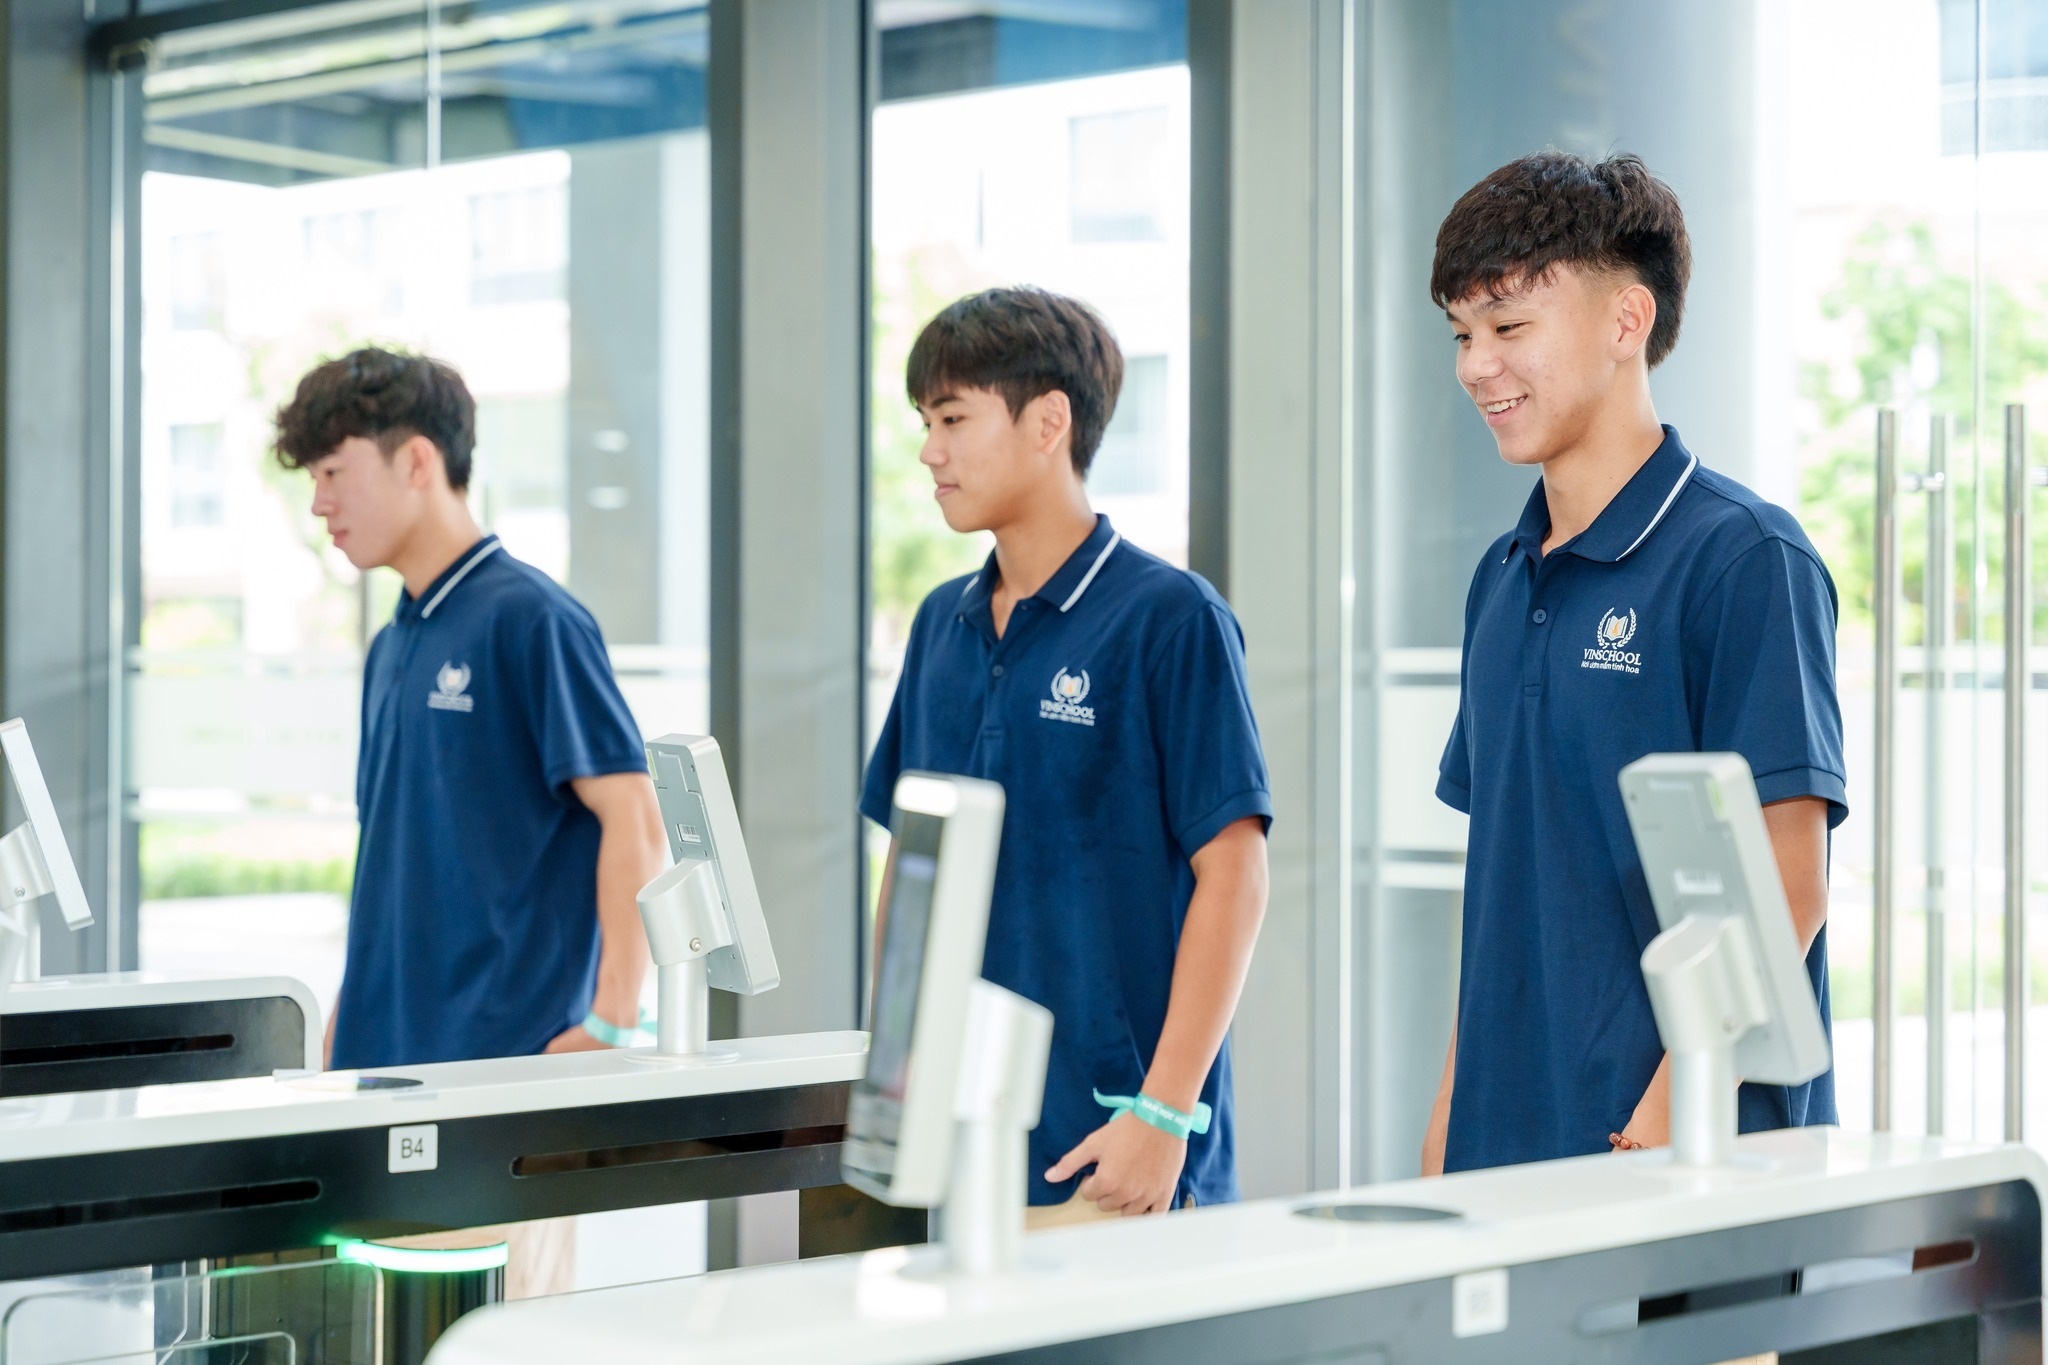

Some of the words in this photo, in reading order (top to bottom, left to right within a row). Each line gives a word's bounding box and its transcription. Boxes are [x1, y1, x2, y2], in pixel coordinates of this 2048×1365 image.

[1583, 648, 1642, 666] VINSCHOOL
[1625, 664, 1640, 674] hoa
[401, 1137, 424, 1159] B4
